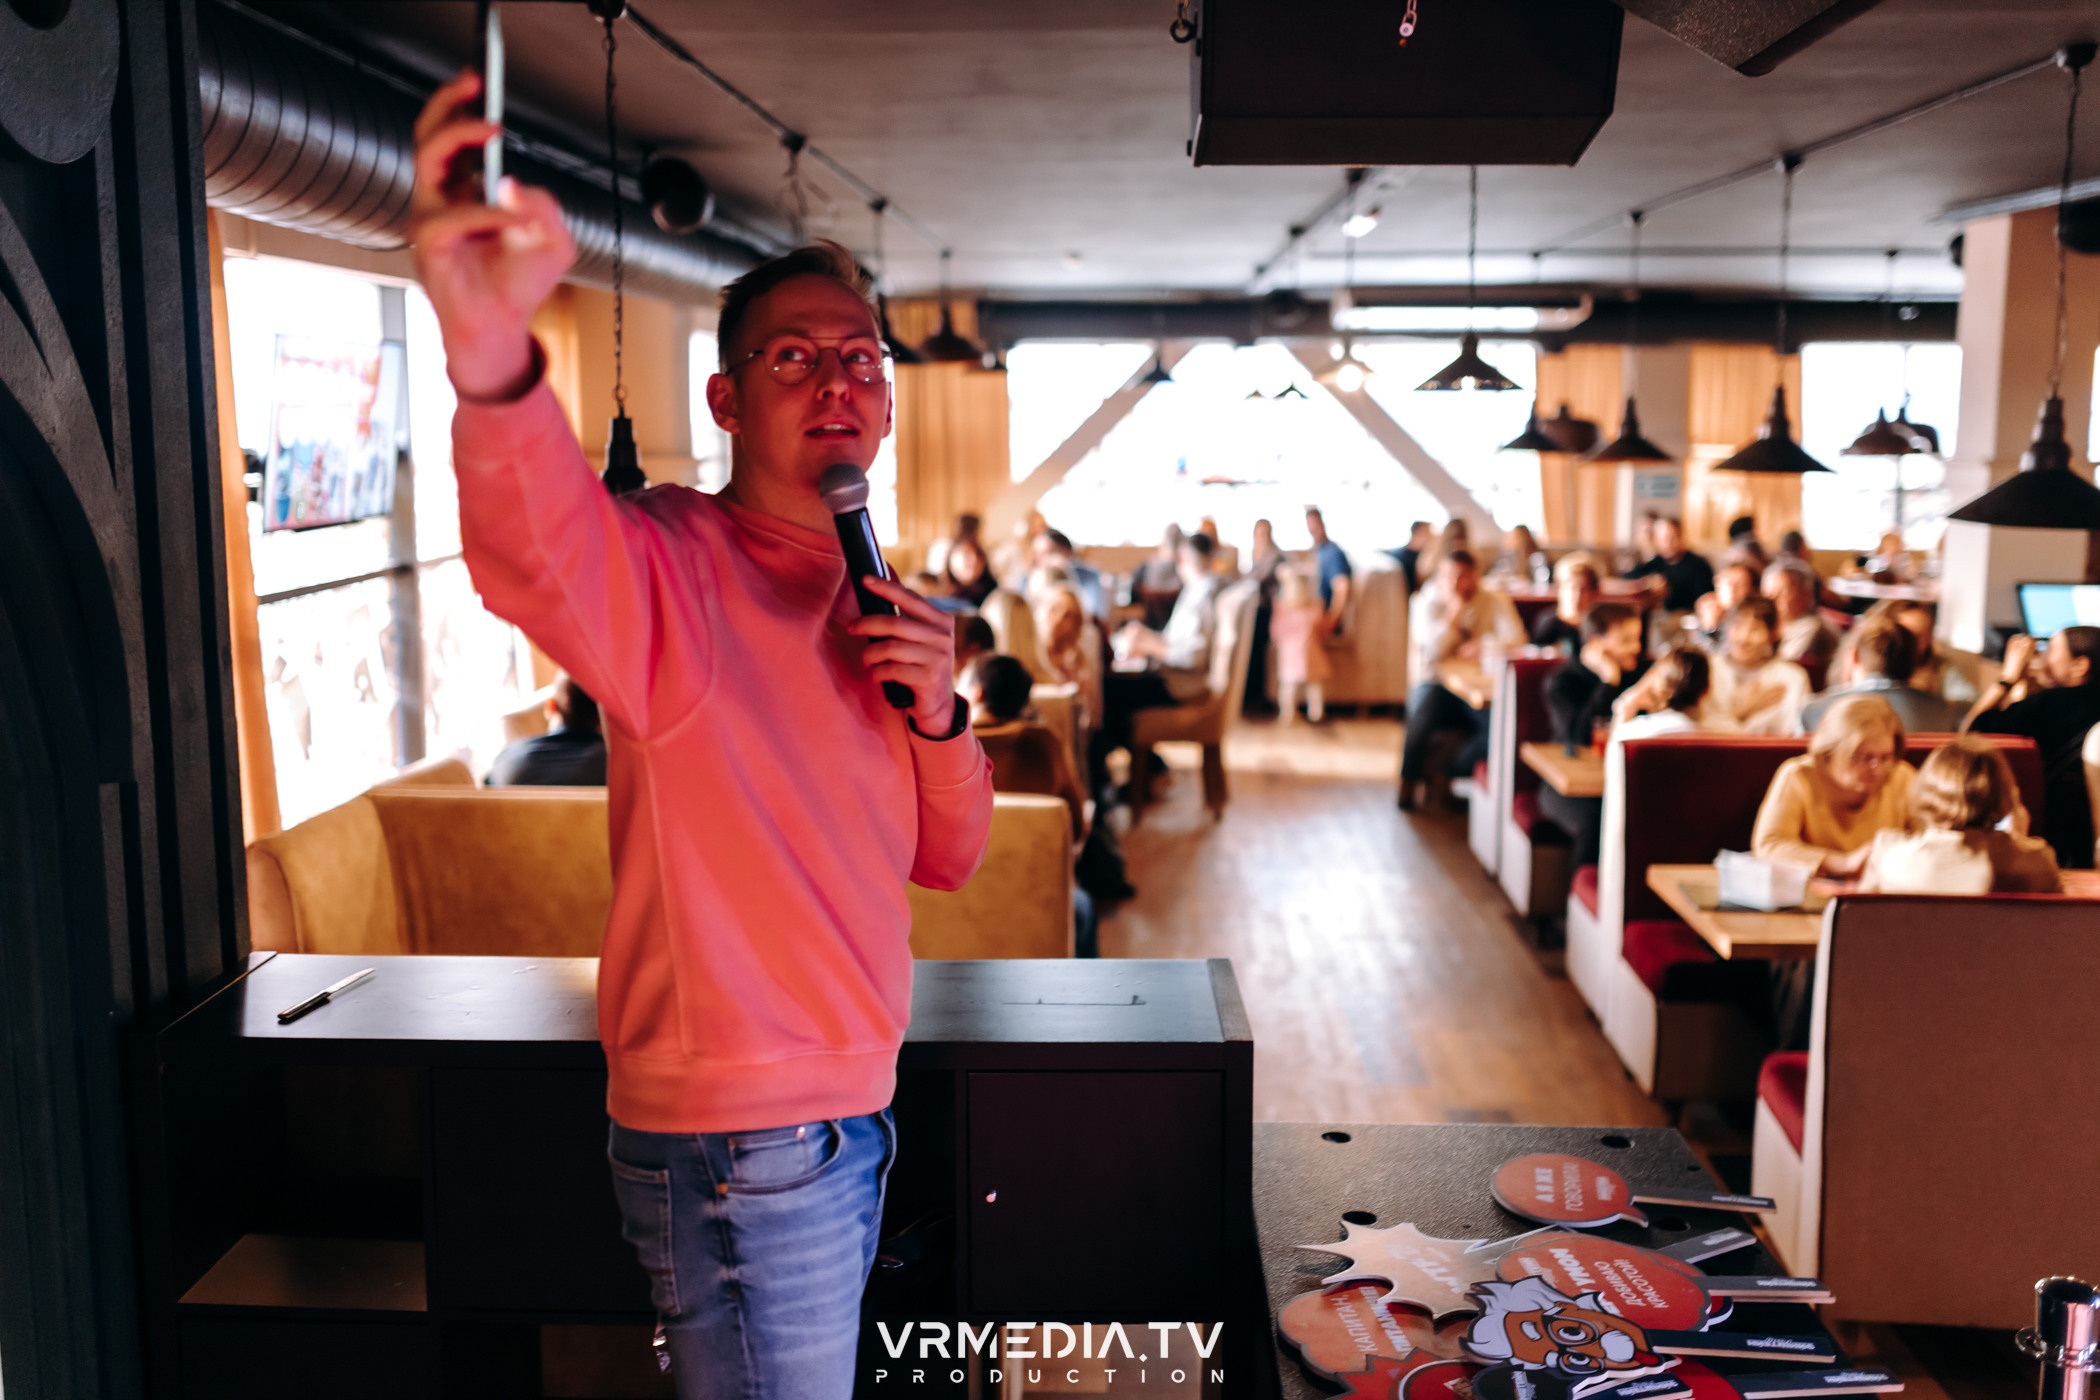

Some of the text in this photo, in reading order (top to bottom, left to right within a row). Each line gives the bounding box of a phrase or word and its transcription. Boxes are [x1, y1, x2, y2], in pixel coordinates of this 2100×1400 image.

[1549, 1248, 1596, 1287] УМОМ
[1594, 1260, 1647, 1308] ДОБИВАЮ
[1613, 1258, 1669, 1309] КРАСОТОЙ!
[1330, 1294, 1379, 1352] КАПИТАН,
